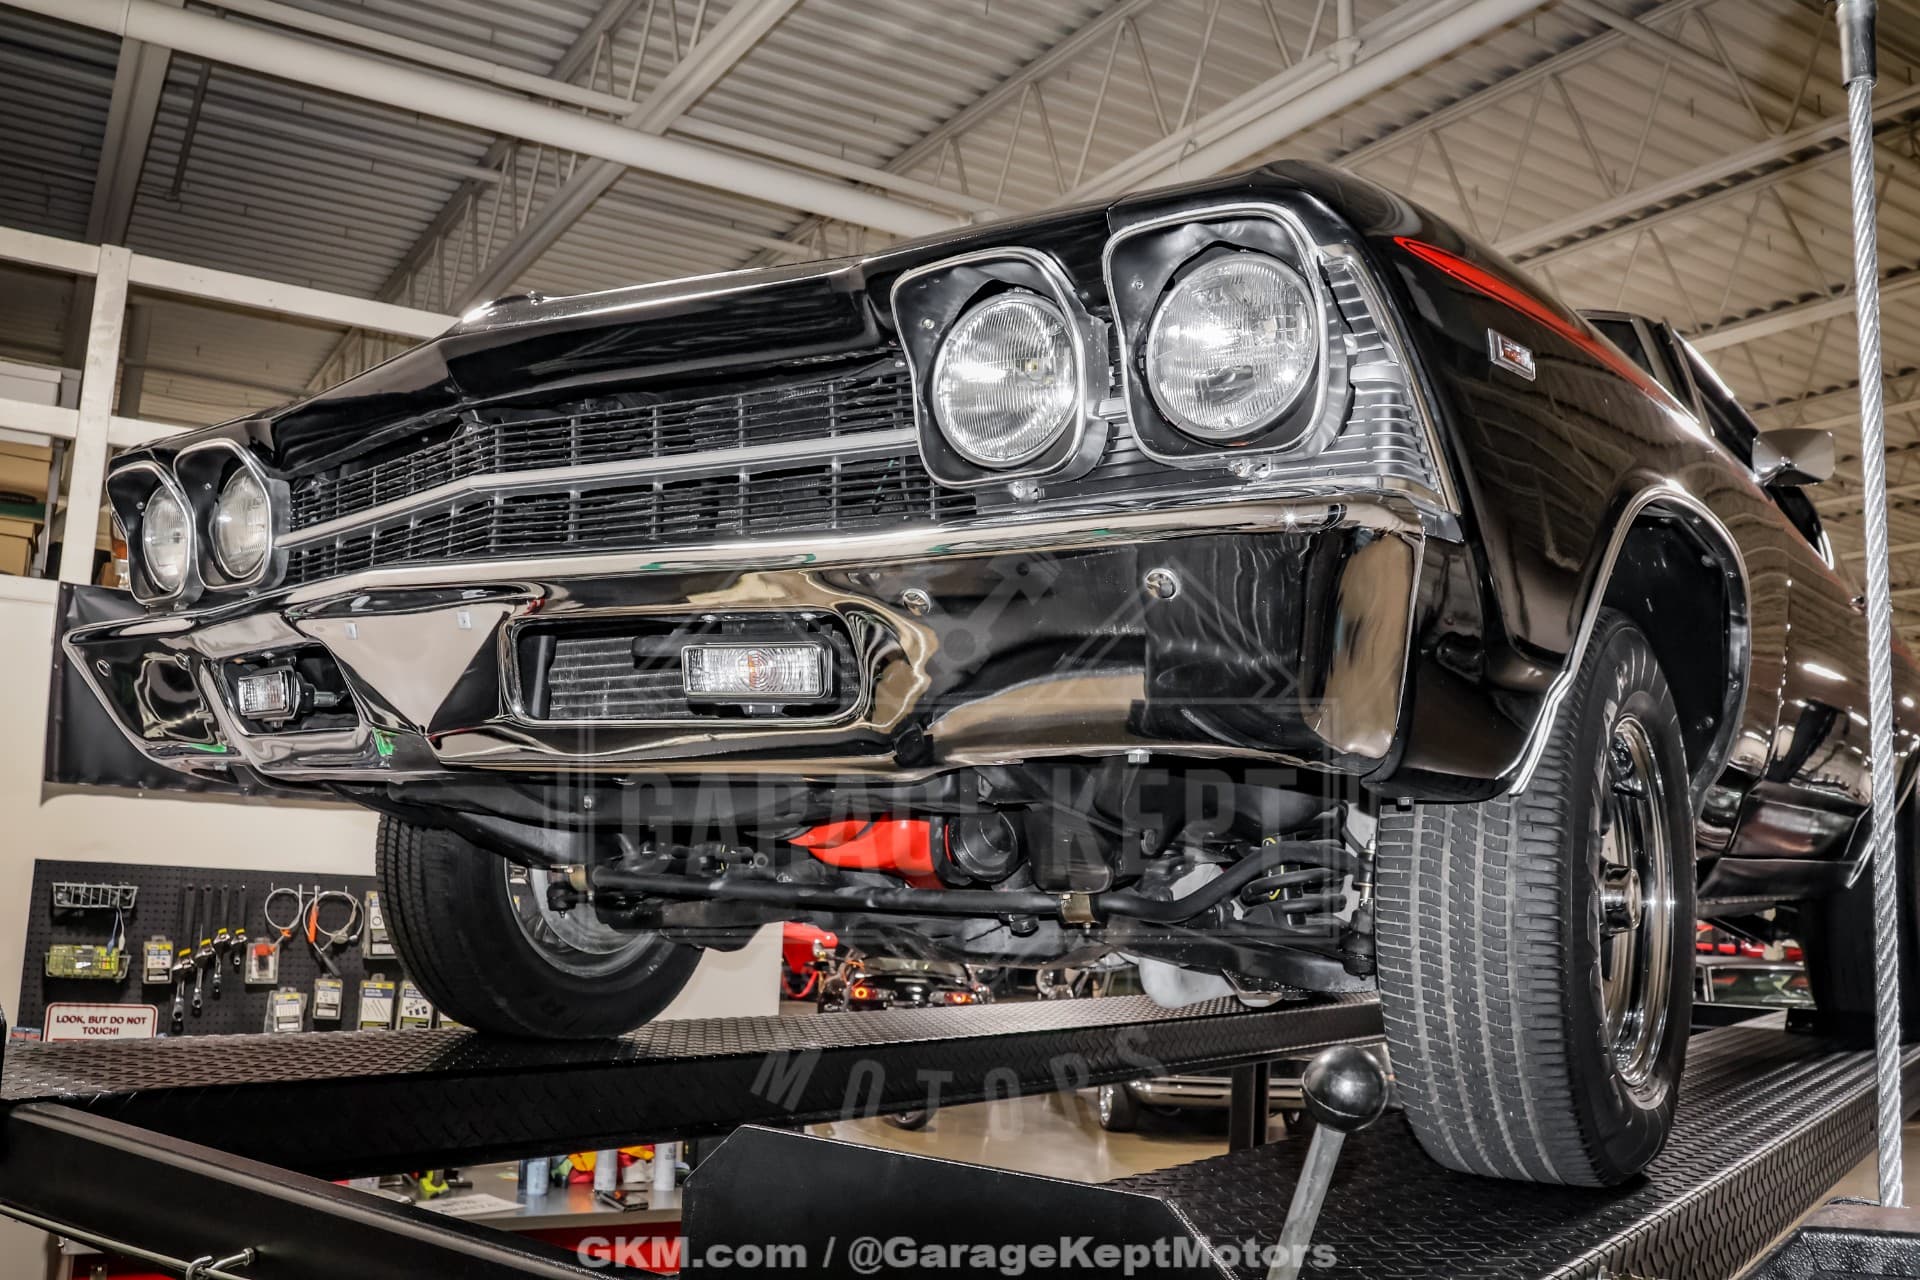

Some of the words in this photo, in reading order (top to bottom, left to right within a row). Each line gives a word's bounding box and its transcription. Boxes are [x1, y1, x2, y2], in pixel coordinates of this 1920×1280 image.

[56, 1015, 86, 1025] LOOK,
[88, 1015, 108, 1024] BUT
[110, 1016, 125, 1025] DO
[127, 1016, 147, 1025] NOT
[82, 1026, 120, 1036] TOUCH!
